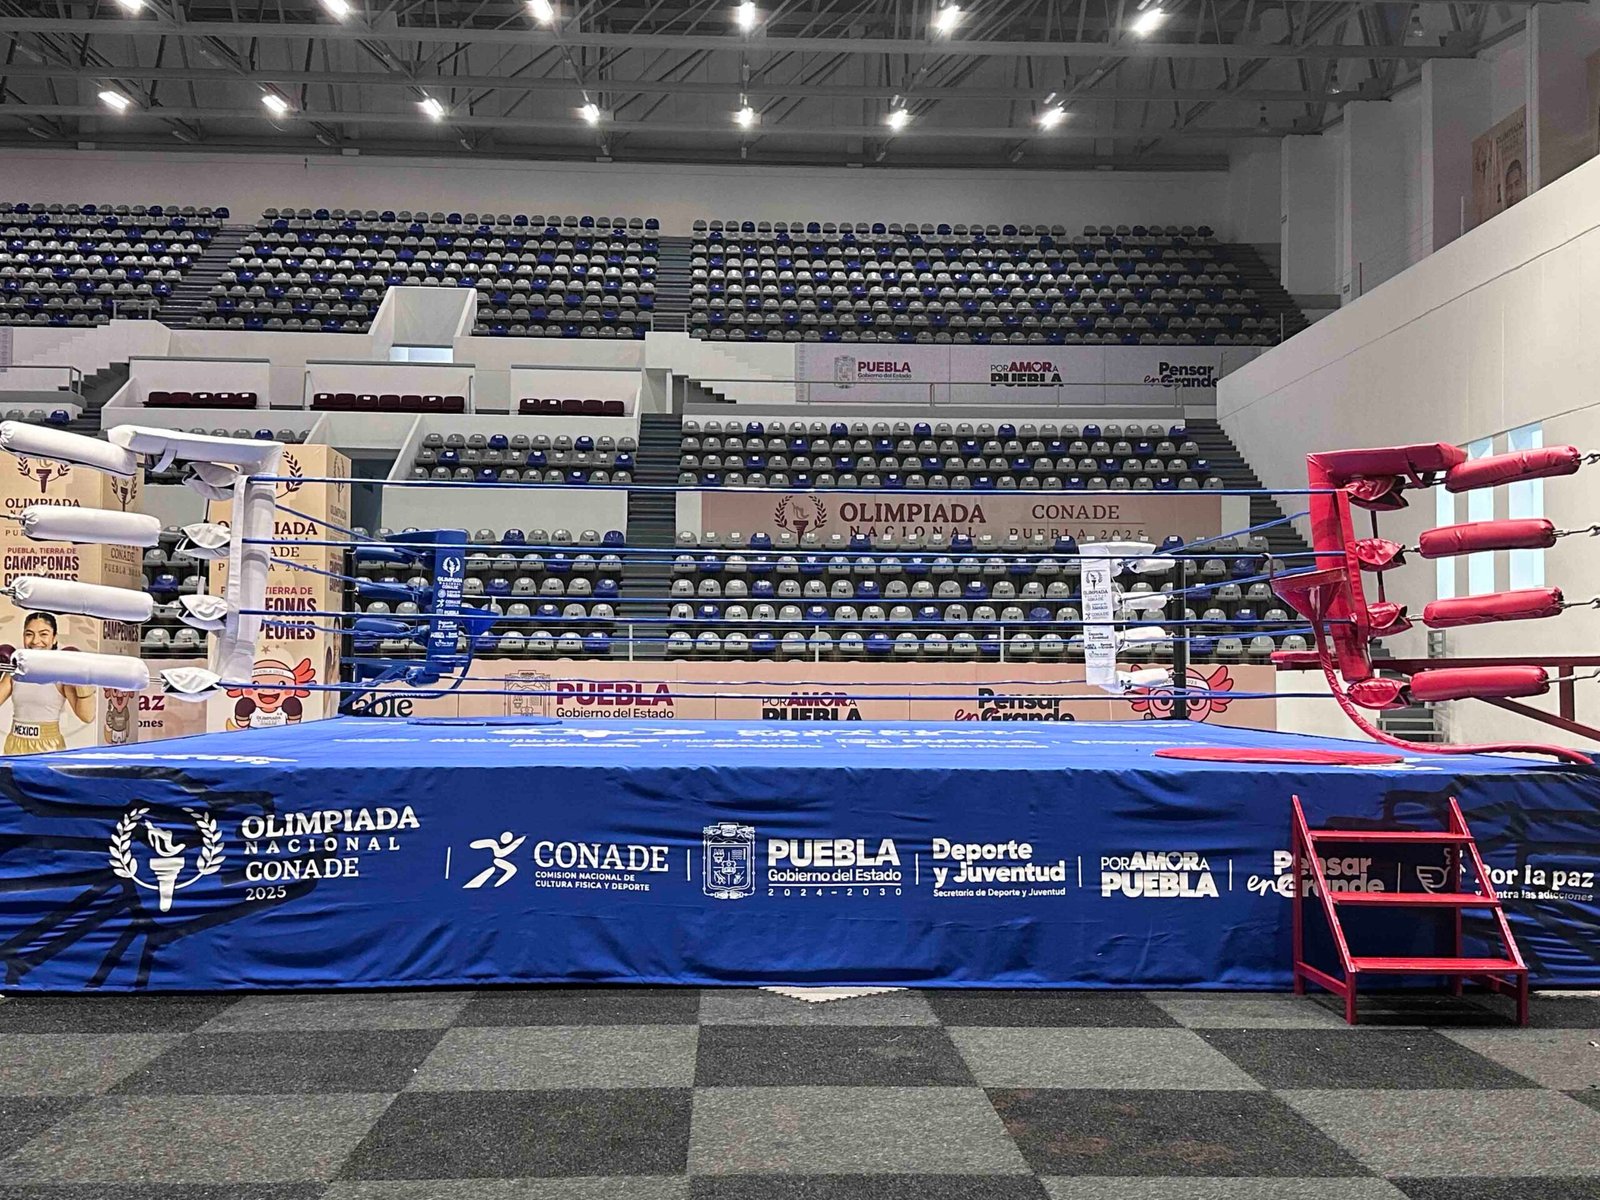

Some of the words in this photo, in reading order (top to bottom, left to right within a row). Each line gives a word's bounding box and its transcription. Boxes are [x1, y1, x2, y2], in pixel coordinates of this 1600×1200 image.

[858, 361, 911, 372] PUEBLA
[990, 364, 1008, 372] POR
[1009, 361, 1052, 372] AMOR
[1159, 361, 1214, 376] Pensar
[990, 373, 1064, 387] PUEBLA
[839, 502, 987, 523] OLIMPIADA
[1032, 504, 1120, 520] CONADE
[300, 587, 313, 595] DE
[264, 598, 317, 615] EONAS
[139, 694, 165, 711] az
[556, 683, 674, 706] PUEBLA
[787, 692, 848, 707] AMOR
[978, 688, 1063, 709] Pensar
[556, 708, 611, 718] Gobierno
[613, 708, 630, 718] del
[633, 708, 674, 719] Estado
[241, 805, 420, 839] OLIMPIADA
[244, 836, 400, 855] NACIONAL
[767, 839, 901, 867] PUEBLA
[932, 838, 1032, 861] Deporte
[533, 840, 669, 872] CONADE
[1101, 857, 1129, 870] POR
[1129, 852, 1200, 871] AMOR
[1199, 860, 1210, 870] A
[245, 857, 359, 882] CONADE
[535, 871, 576, 879] COMISION
[579, 873, 621, 881] NACIONAL
[768, 869, 831, 882] Gobierno
[832, 869, 853, 881] del
[855, 869, 901, 881] Estado
[933, 866, 948, 888] y
[953, 860, 1066, 883] Juventud
[1524, 864, 1546, 885] la
[1552, 870, 1595, 891] paz
[245, 885, 287, 901] 2025
[575, 881, 602, 889] FISICA
[612, 882, 650, 891] DEPORTE
[976, 888, 986, 896] de
[988, 888, 1020, 898] Deporte
[1021, 890, 1027, 898] y
[1029, 887, 1066, 896] Juventud
[1101, 872, 1219, 897] PUEBLA
[1496, 890, 1519, 899] ntra
[1537, 891, 1594, 901] adicciones
